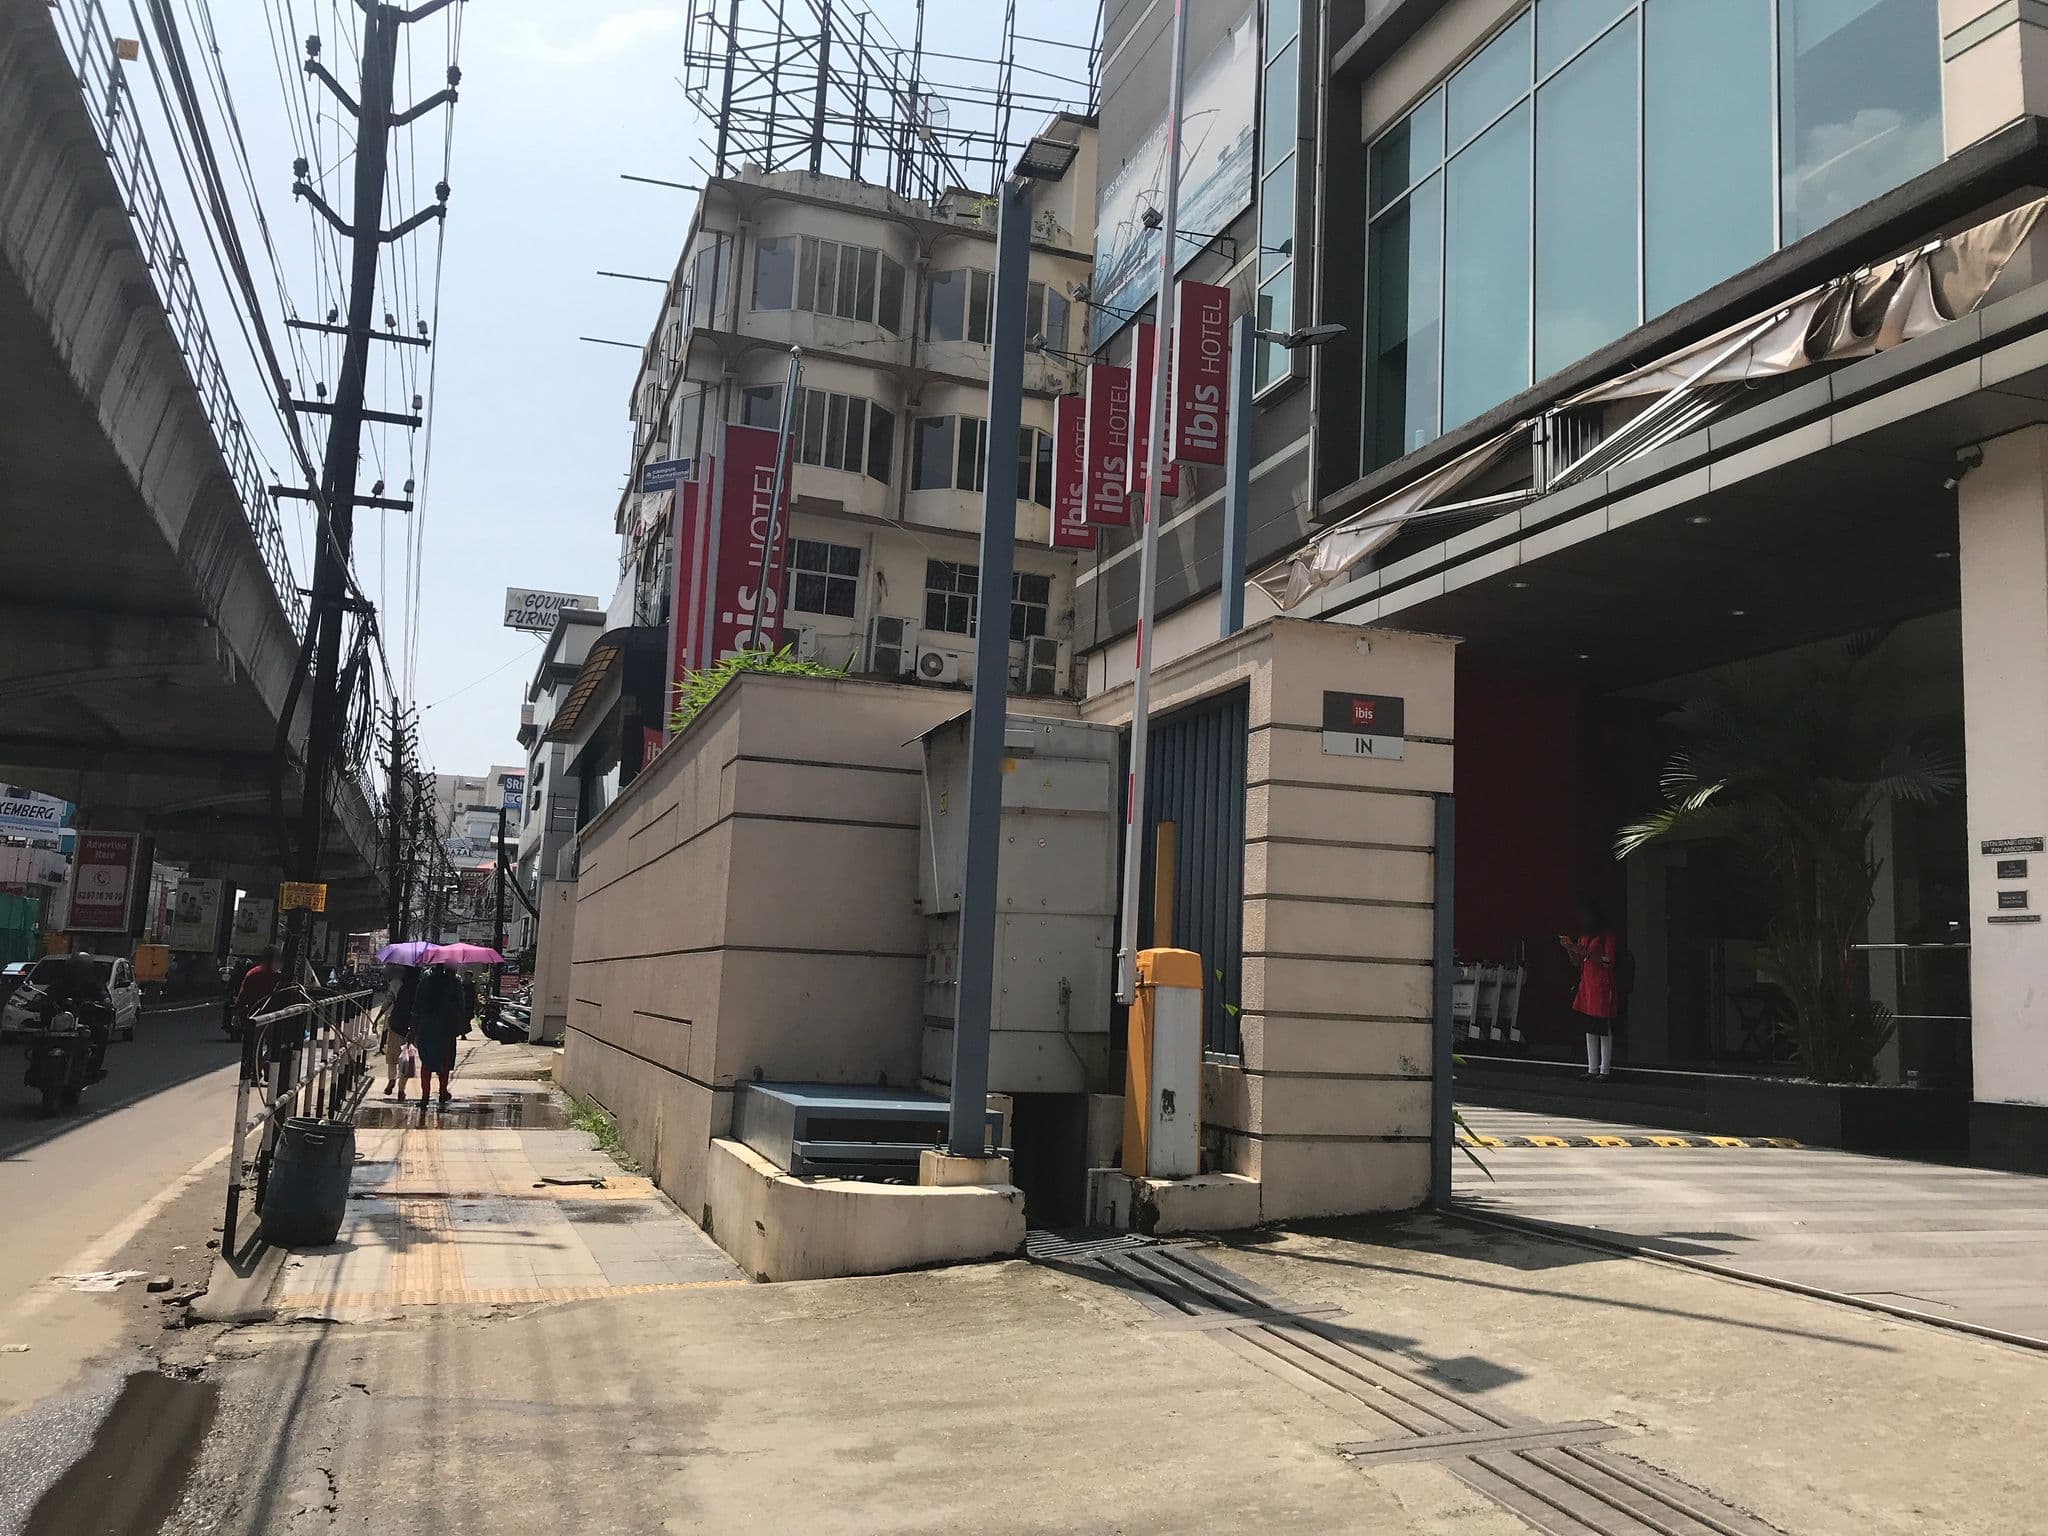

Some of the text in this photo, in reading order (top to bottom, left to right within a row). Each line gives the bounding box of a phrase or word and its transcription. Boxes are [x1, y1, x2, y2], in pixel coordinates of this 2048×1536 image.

[1185, 298, 1222, 450] ibis HOTEL
[1094, 379, 1129, 513] ibis HOTEL
[1355, 706, 1374, 719] ibis
[1355, 737, 1373, 754] IN
